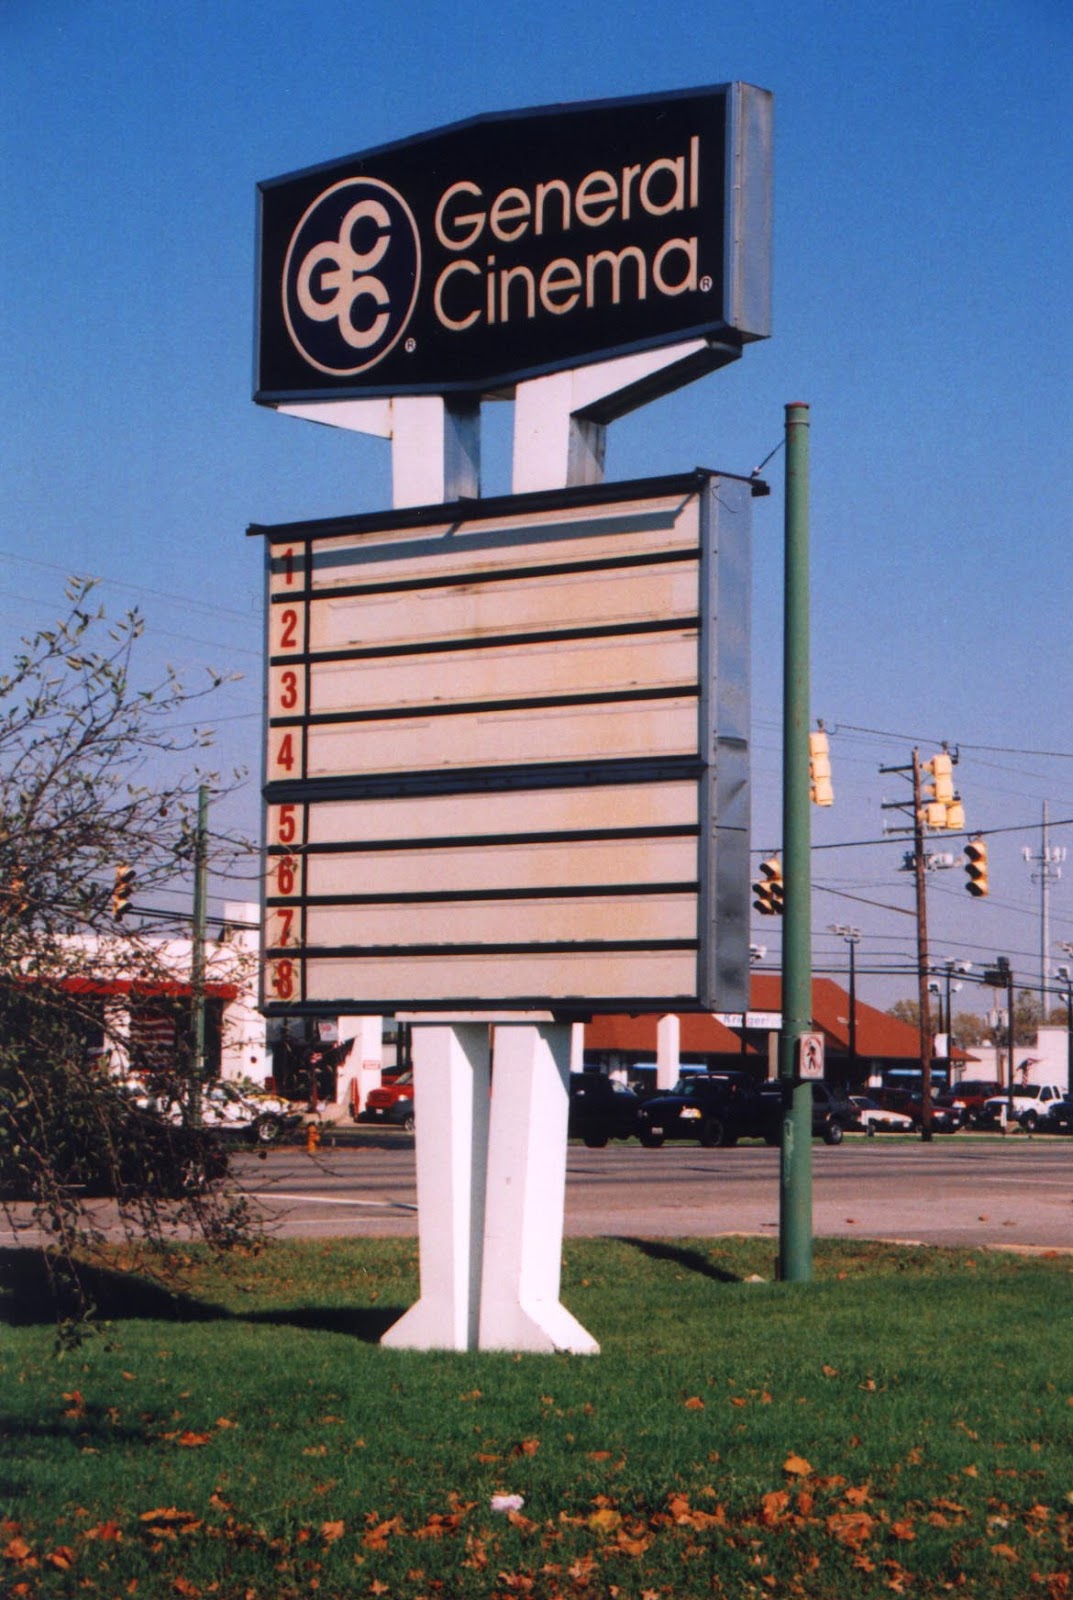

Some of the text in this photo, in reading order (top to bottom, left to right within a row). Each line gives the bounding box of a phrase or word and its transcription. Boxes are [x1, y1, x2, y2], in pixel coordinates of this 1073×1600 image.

[435, 136, 699, 251] General
[281, 547, 294, 585] 1
[280, 609, 298, 648] 2
[280, 671, 298, 709] 3
[277, 733, 294, 771] 4
[278, 805, 296, 843] 5
[277, 855, 294, 895] 6
[276, 909, 294, 947] 7
[276, 958, 294, 999] 8
[723, 1014, 766, 1027] Kriger
